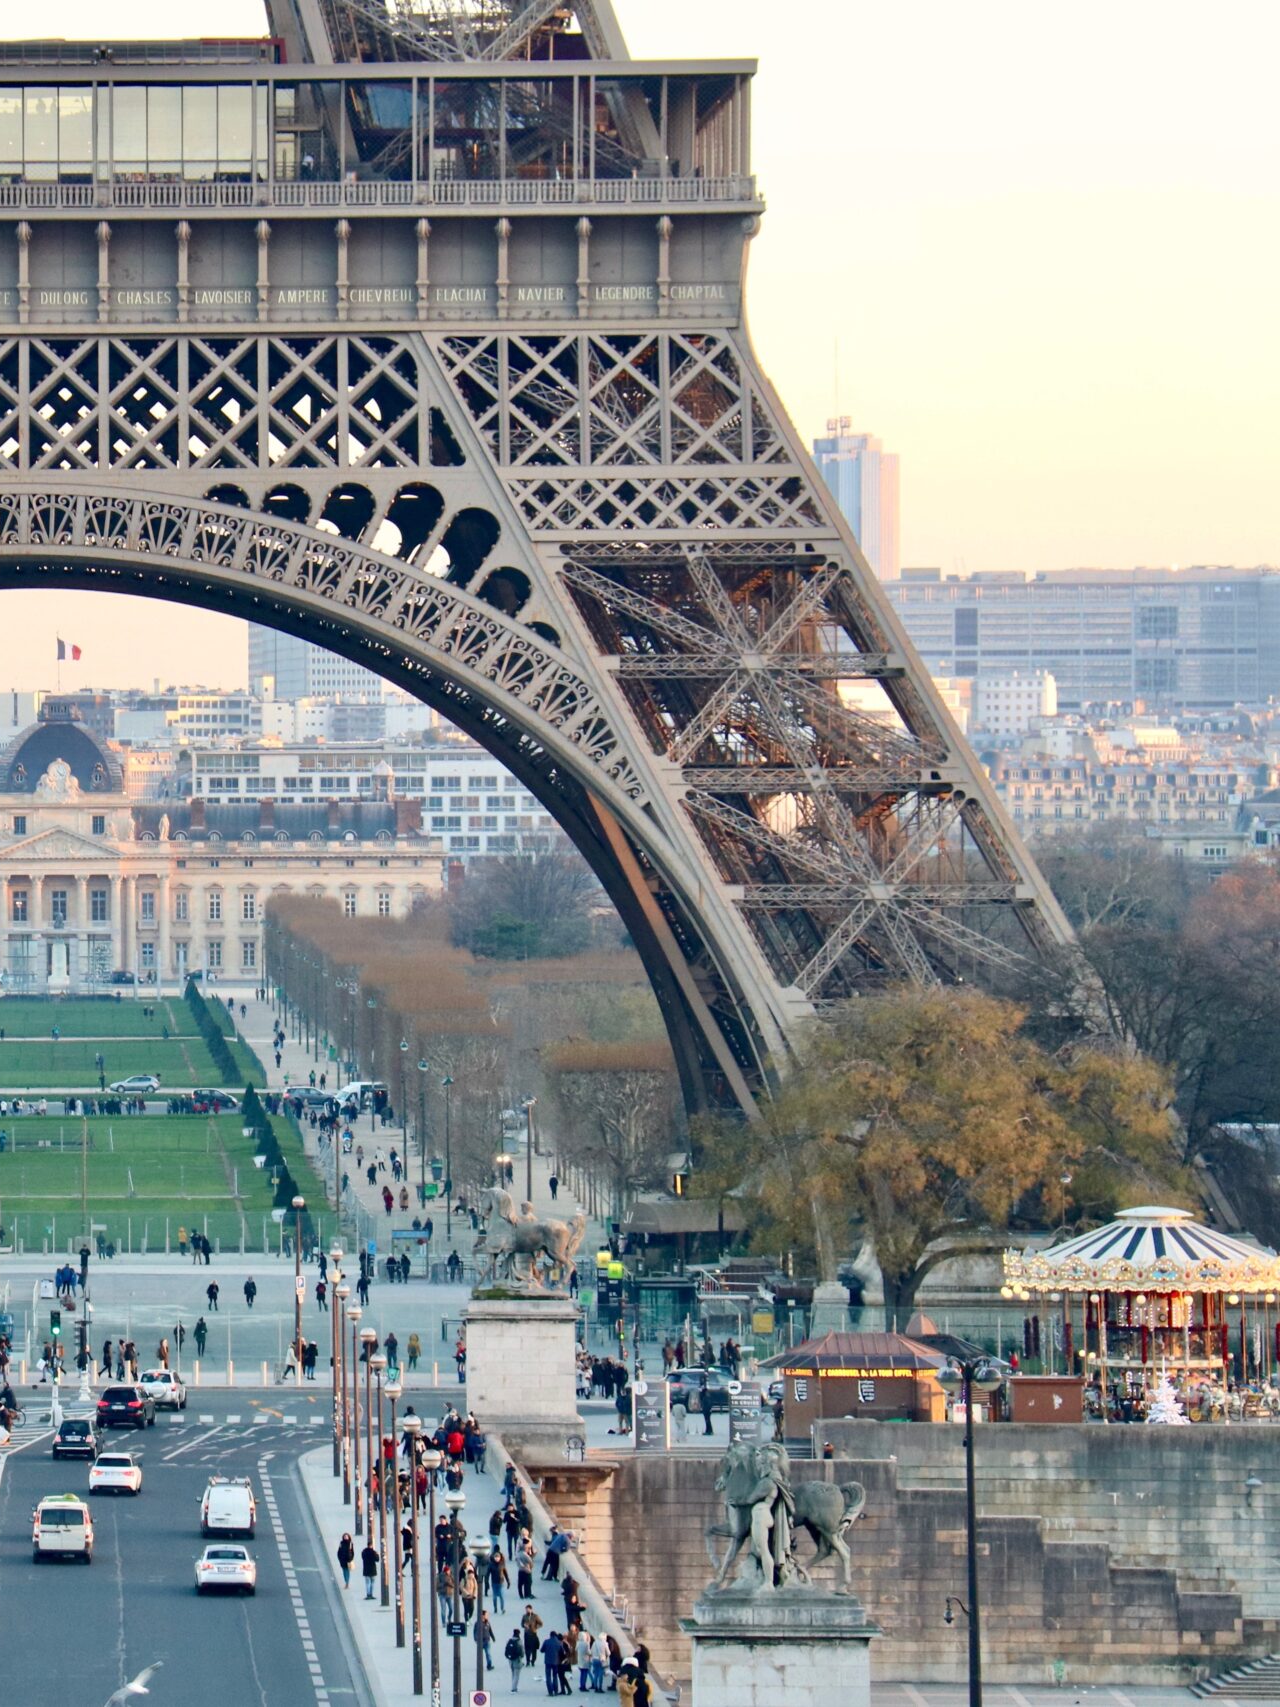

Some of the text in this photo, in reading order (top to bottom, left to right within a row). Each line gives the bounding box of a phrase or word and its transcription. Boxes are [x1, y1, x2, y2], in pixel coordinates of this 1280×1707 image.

[40, 291, 88, 305] DULONG
[117, 291, 172, 305] CHASLES
[194, 291, 252, 304] LAVOISIER
[277, 290, 328, 304] AMPERE
[349, 289, 414, 303] CHEVREUL
[436, 288, 487, 302] FLACHAT
[517, 287, 564, 301] NAVIER
[595, 286, 654, 300] LEGENDRE
[670, 286, 725, 300] CHAPTAL
